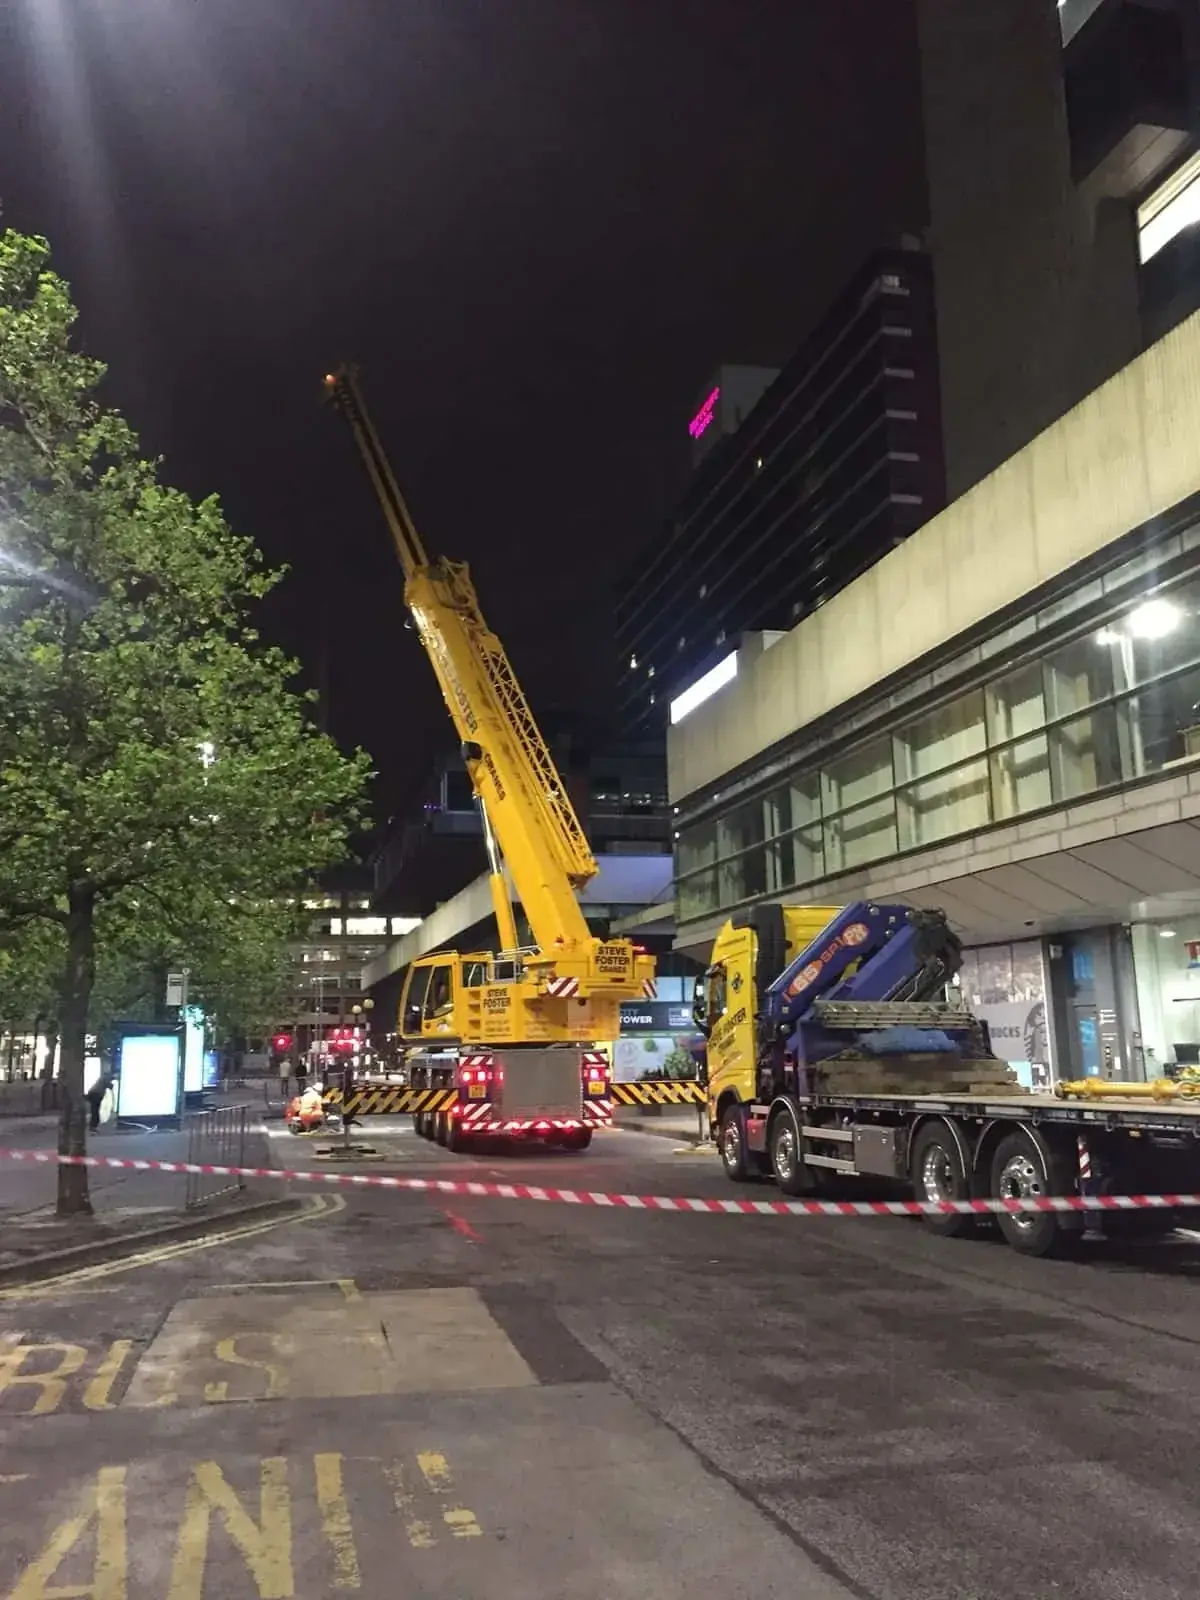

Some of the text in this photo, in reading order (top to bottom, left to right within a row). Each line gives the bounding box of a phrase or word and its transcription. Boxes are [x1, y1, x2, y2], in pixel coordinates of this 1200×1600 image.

[598, 946, 627, 955] STEVE
[595, 955, 630, 965] FOSTER
[483, 997, 511, 1008] FOSTER
